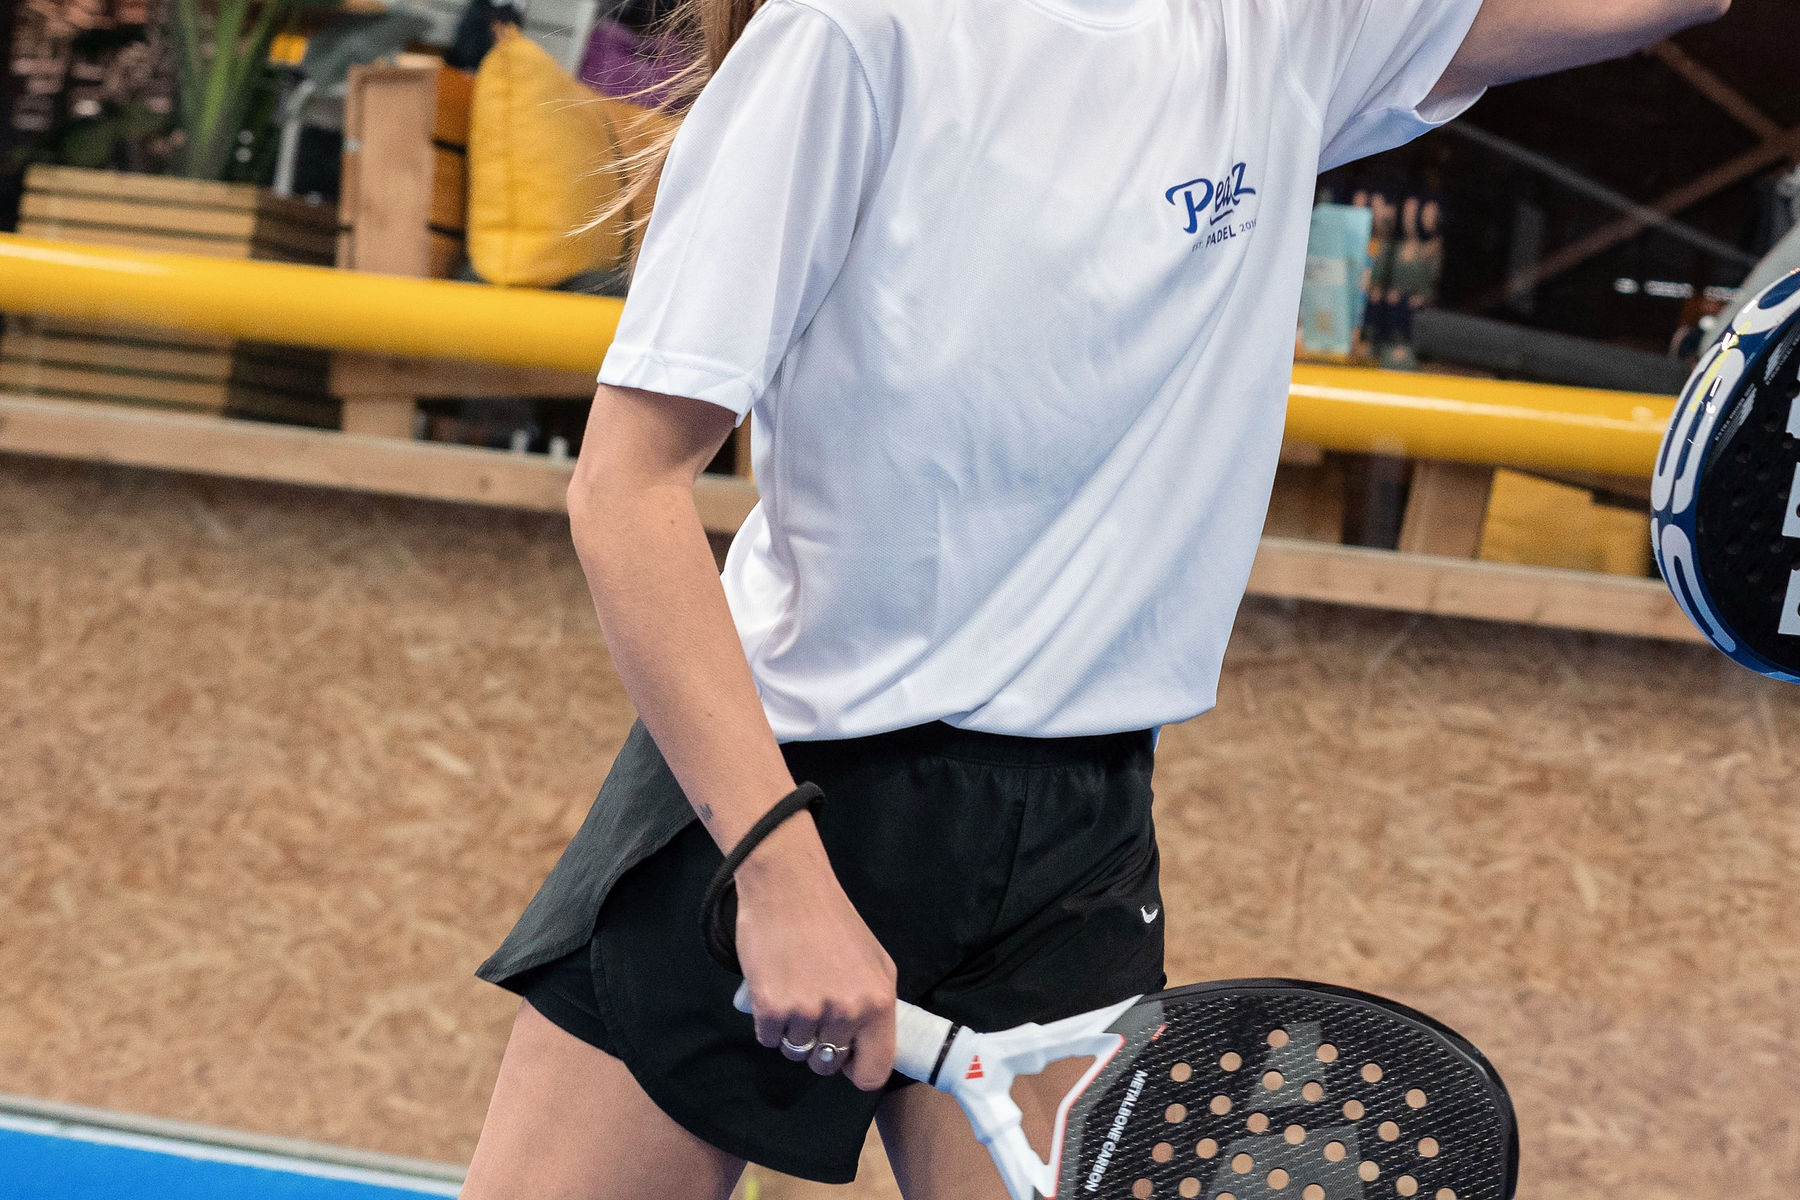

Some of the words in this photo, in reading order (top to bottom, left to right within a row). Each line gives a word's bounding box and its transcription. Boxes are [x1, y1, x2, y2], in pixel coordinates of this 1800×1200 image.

[1205, 224, 1237, 248] PADEL
[1107, 1069, 1149, 1142] METALBONE
[1084, 1141, 1116, 1192] CARBON
